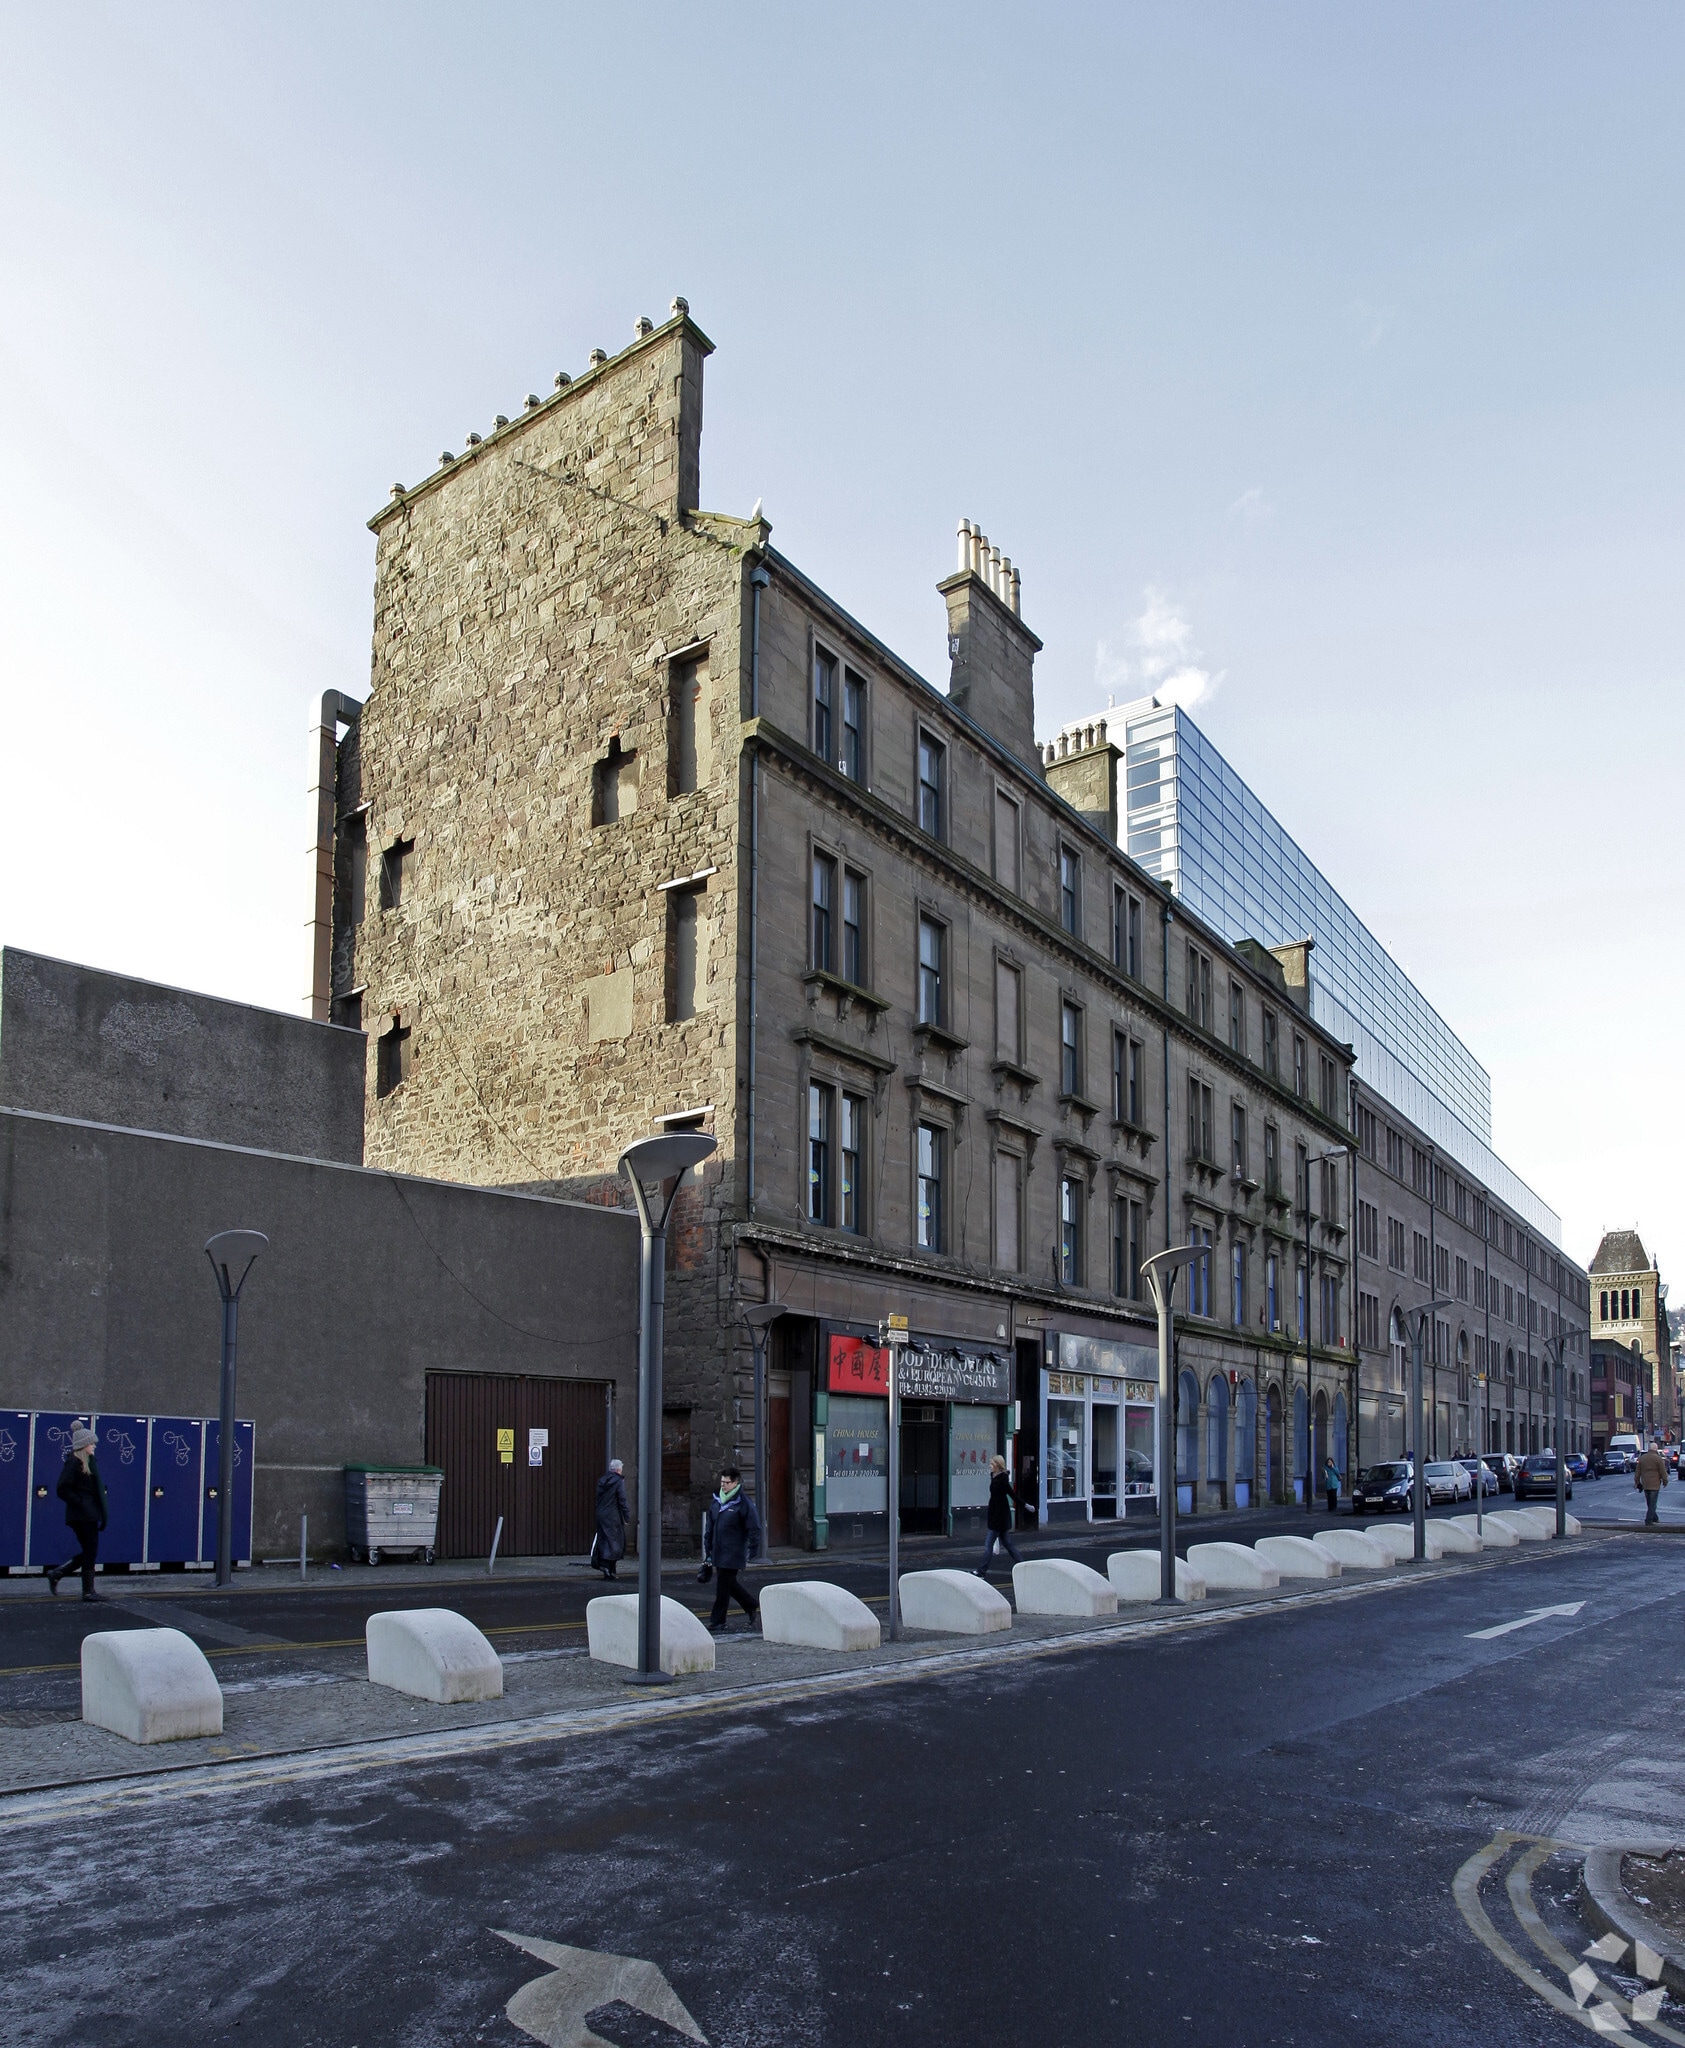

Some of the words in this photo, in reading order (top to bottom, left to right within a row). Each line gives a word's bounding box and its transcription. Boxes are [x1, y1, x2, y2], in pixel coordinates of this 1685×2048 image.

[898, 1367, 906, 1380] &
[911, 1367, 962, 1386] EUROPEAN
[963, 1373, 998, 1388] CUISINE
[833, 1429, 855, 1438] CHINA
[857, 1429, 880, 1439] HOUSE
